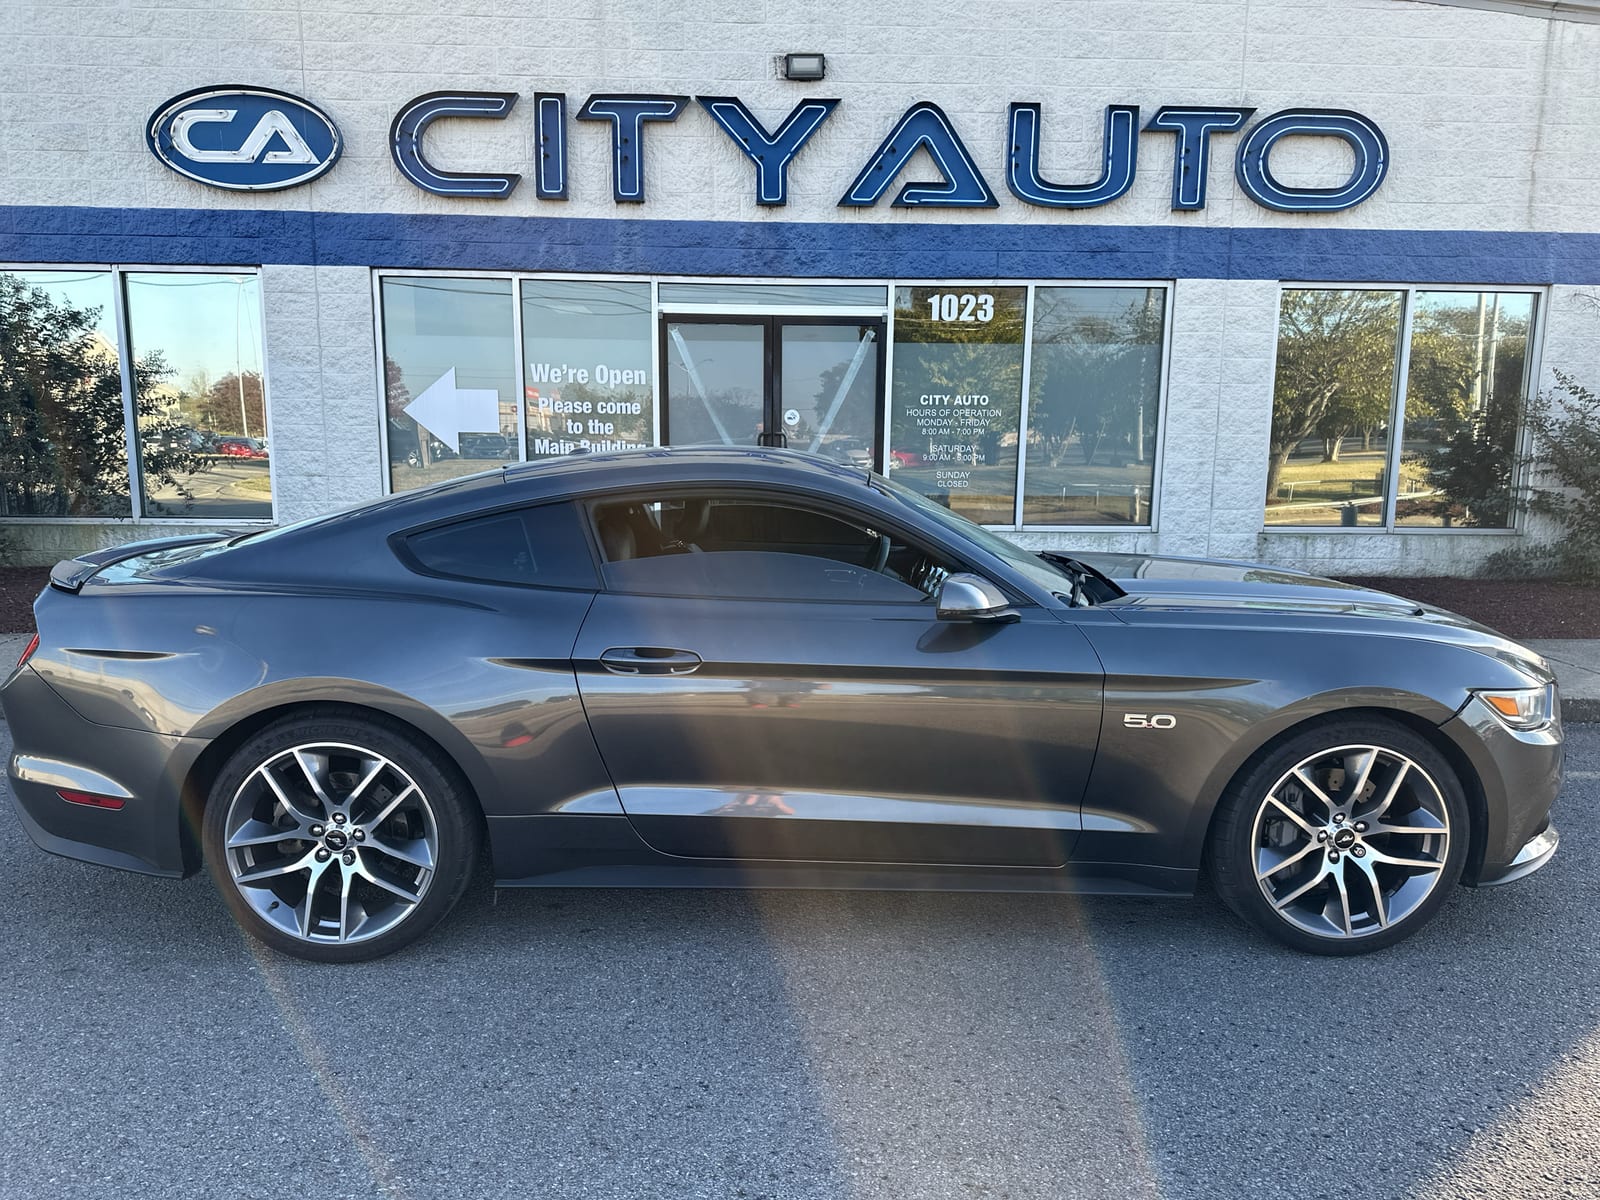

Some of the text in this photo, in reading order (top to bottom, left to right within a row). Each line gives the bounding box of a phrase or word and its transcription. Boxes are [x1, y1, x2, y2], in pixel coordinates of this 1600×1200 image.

[170, 109, 321, 165] CA
[389, 90, 1390, 213] CITY AUTO
[927, 293, 994, 322] 1023
[530, 363, 646, 389] We're Open
[538, 397, 641, 415] Please come
[920, 394, 989, 406] CITY AUTO
[906, 408, 1002, 417] HOURS OF OPERATION
[566, 418, 614, 435] to the
[916, 418, 953, 427] MONDAY
[960, 418, 991, 427] FRIDAY
[534, 438, 575, 455] Main
[932, 444, 977, 453] SATURDAY
[936, 471, 971, 479] SUNDAY
[937, 480, 969, 488] CLOSED
[1123, 713, 1177, 729] 5.0
